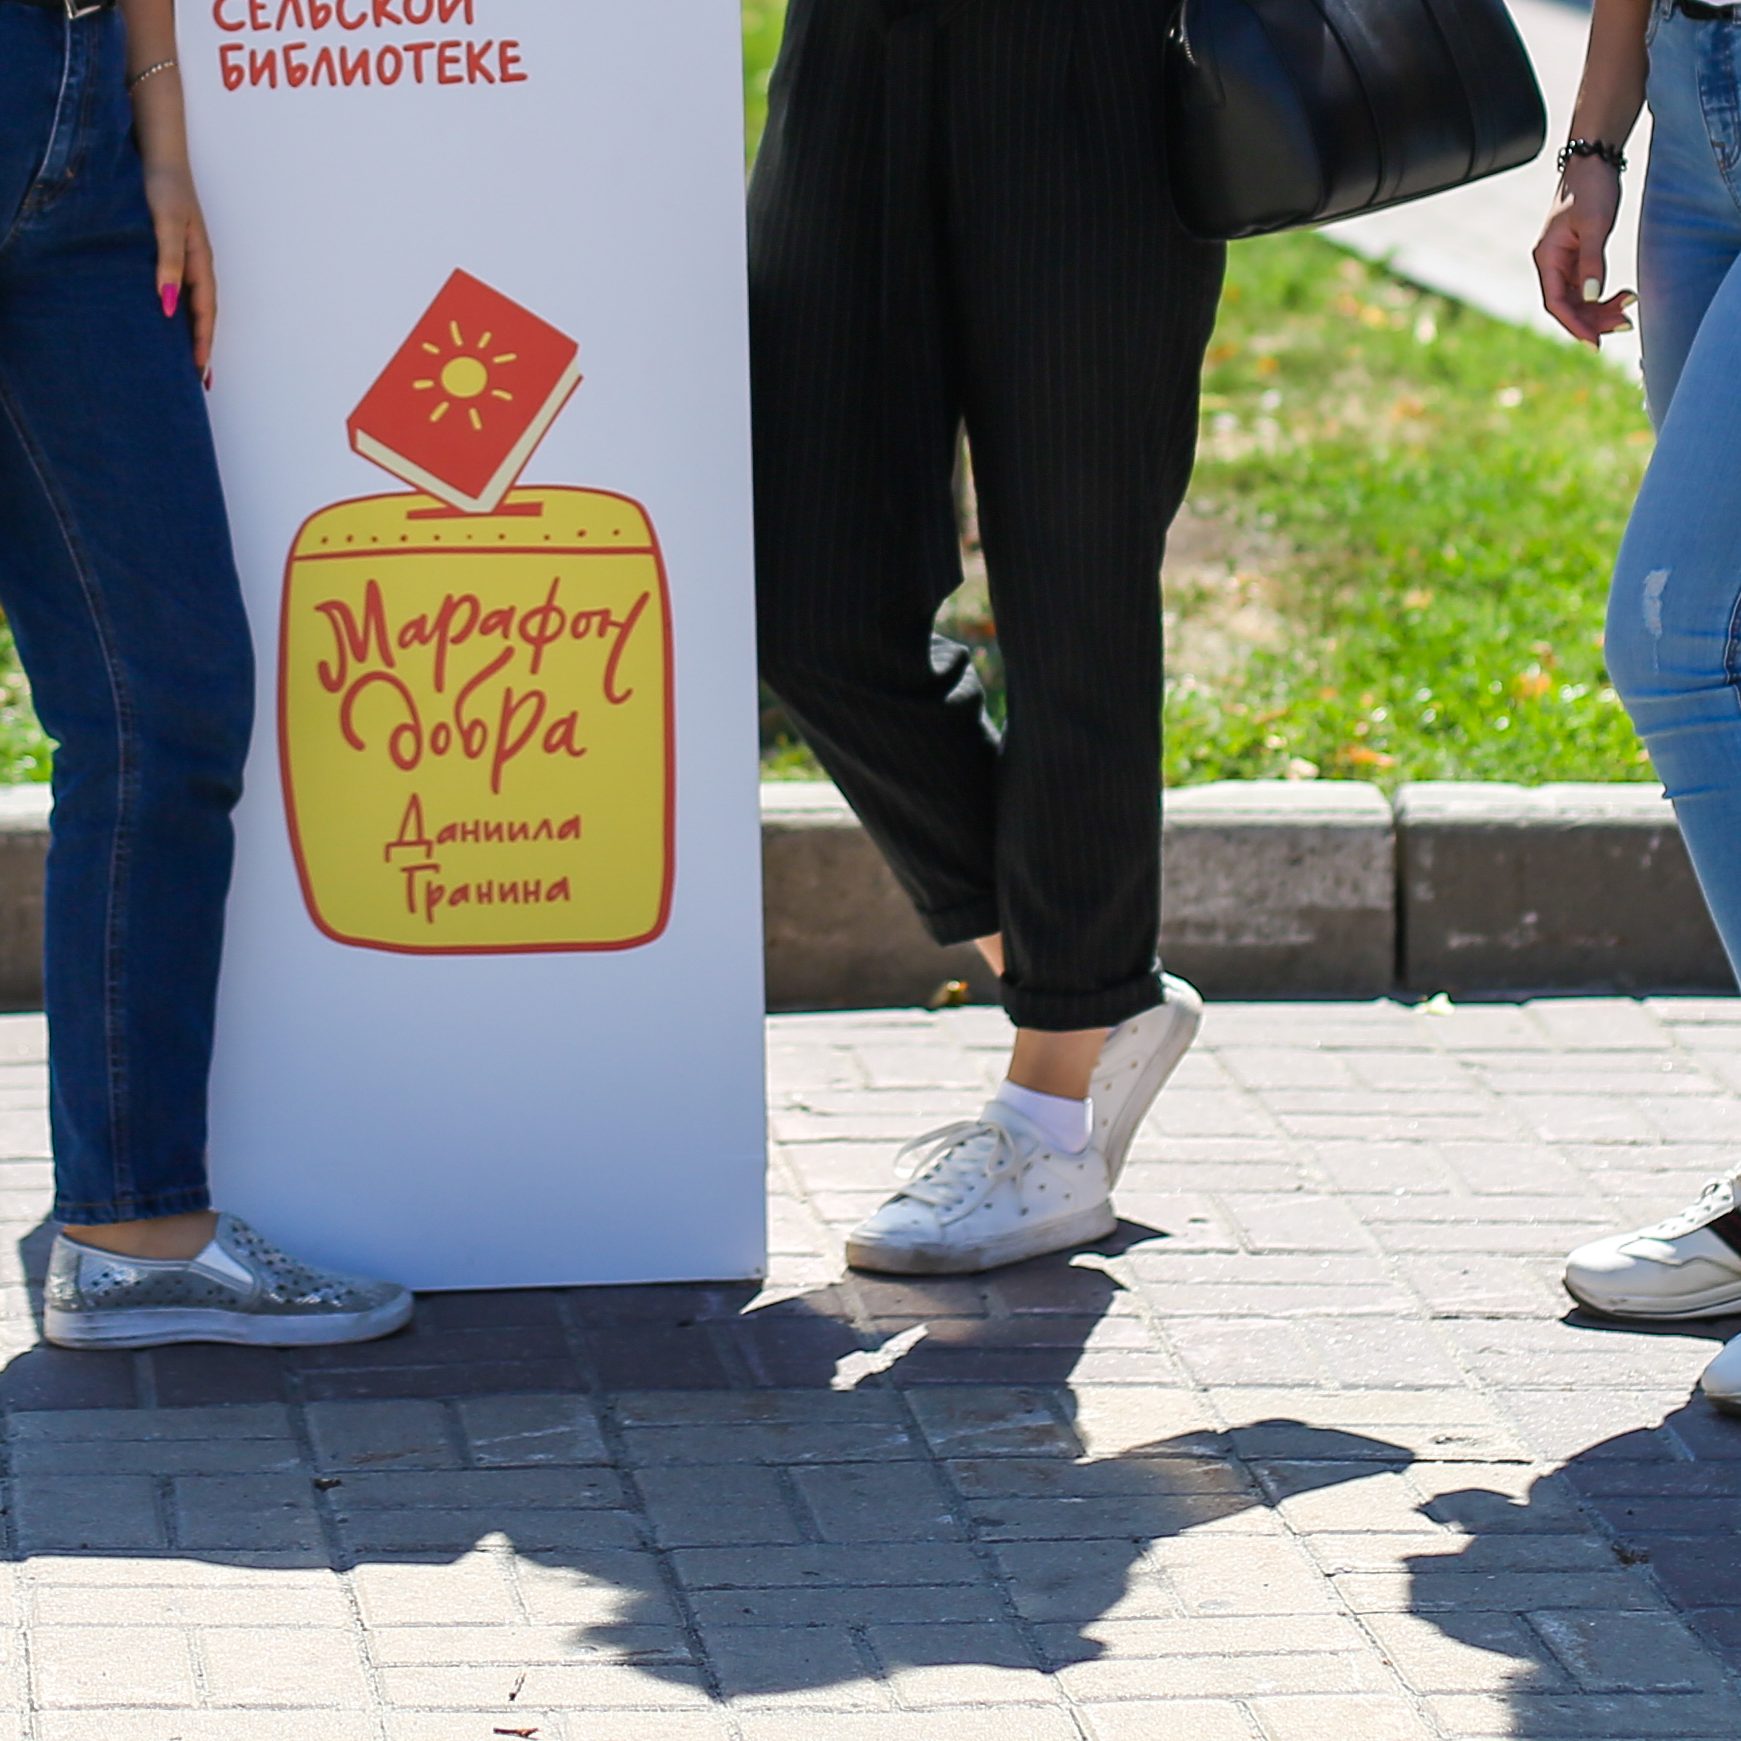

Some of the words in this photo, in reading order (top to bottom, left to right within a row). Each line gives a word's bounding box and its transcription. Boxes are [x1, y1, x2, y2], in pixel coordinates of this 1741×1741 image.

[218, 39, 529, 92] БИБЛИОТЕКЕ
[313, 575, 652, 706] Марафон
[384, 792, 584, 862] Даниила
[400, 863, 572, 925] Гранина
